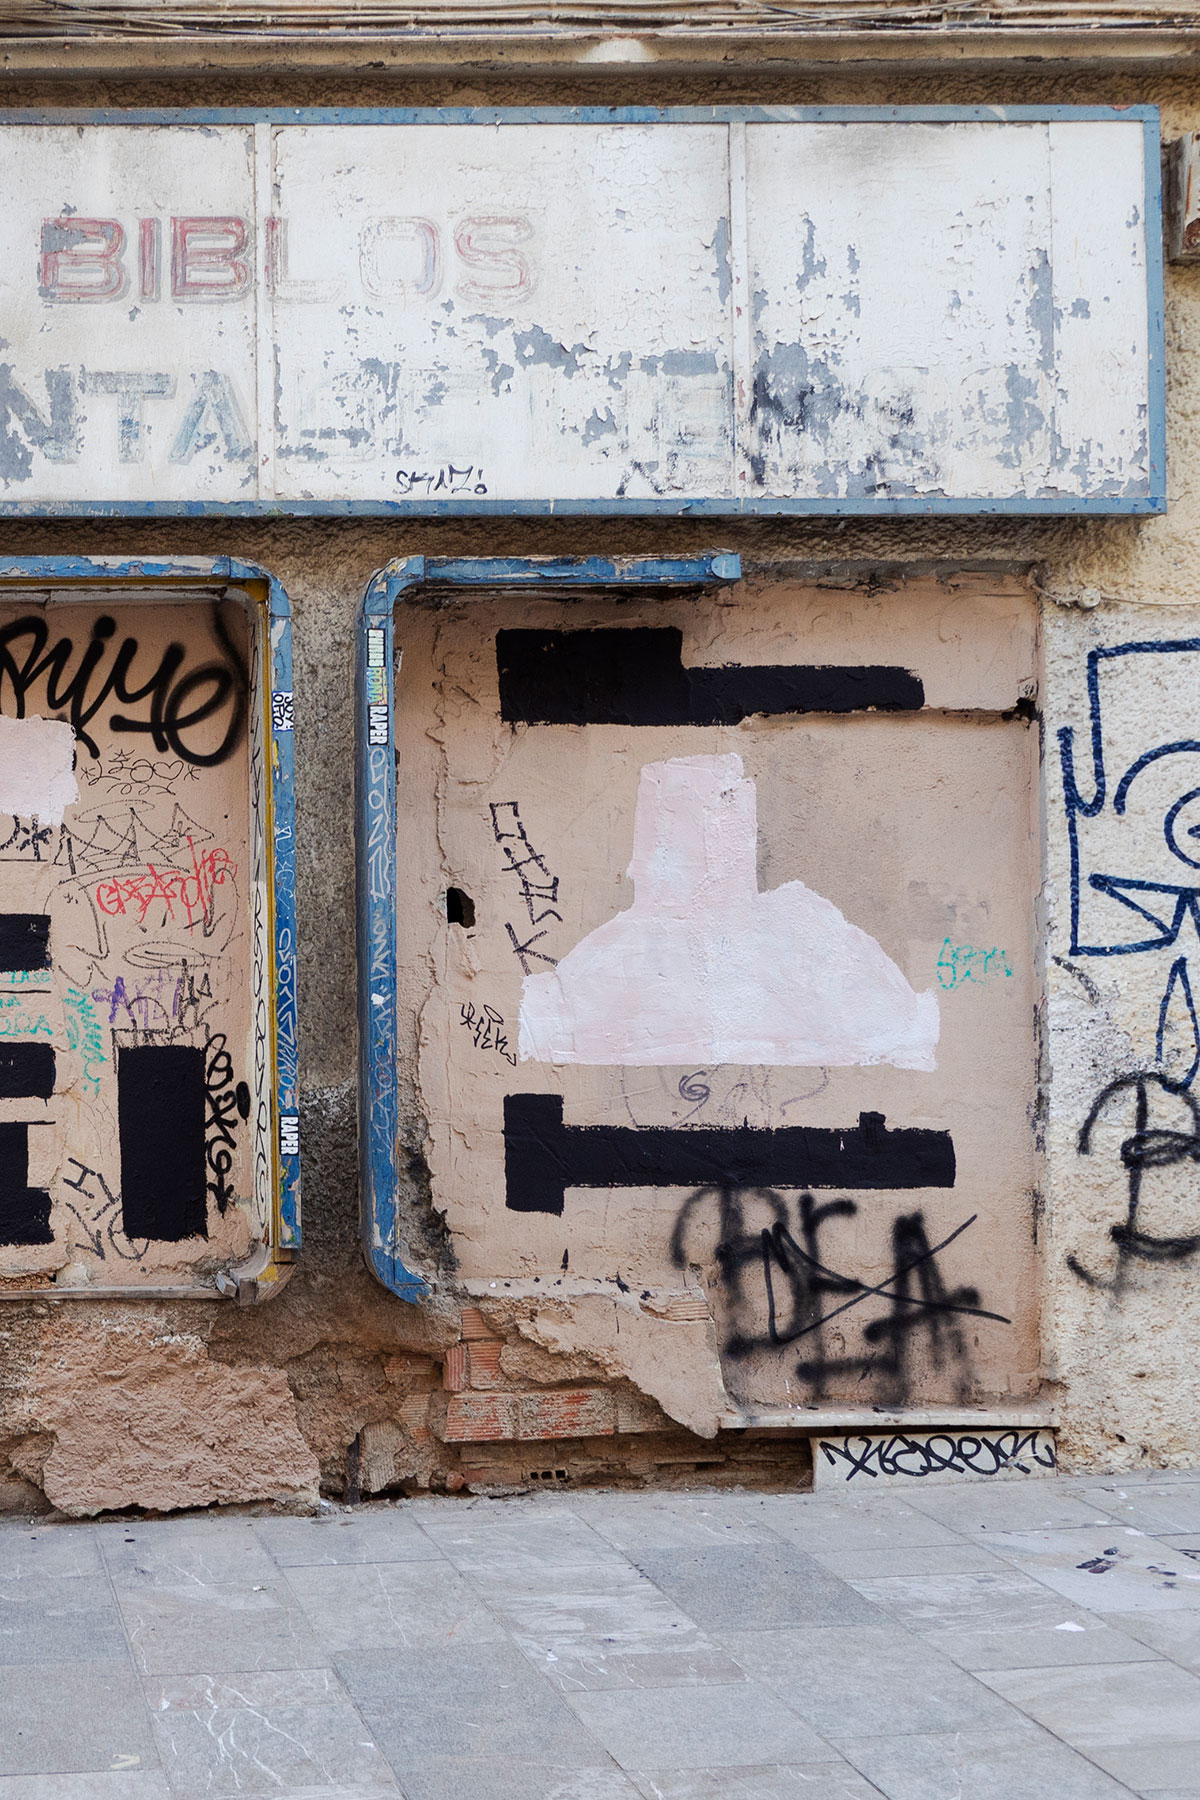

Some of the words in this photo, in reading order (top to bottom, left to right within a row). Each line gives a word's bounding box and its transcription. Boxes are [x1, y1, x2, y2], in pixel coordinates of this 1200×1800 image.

[39, 214, 537, 305] BIBLOS
[369, 705, 388, 745] RAPER
[280, 1116, 299, 1156] RAPER
